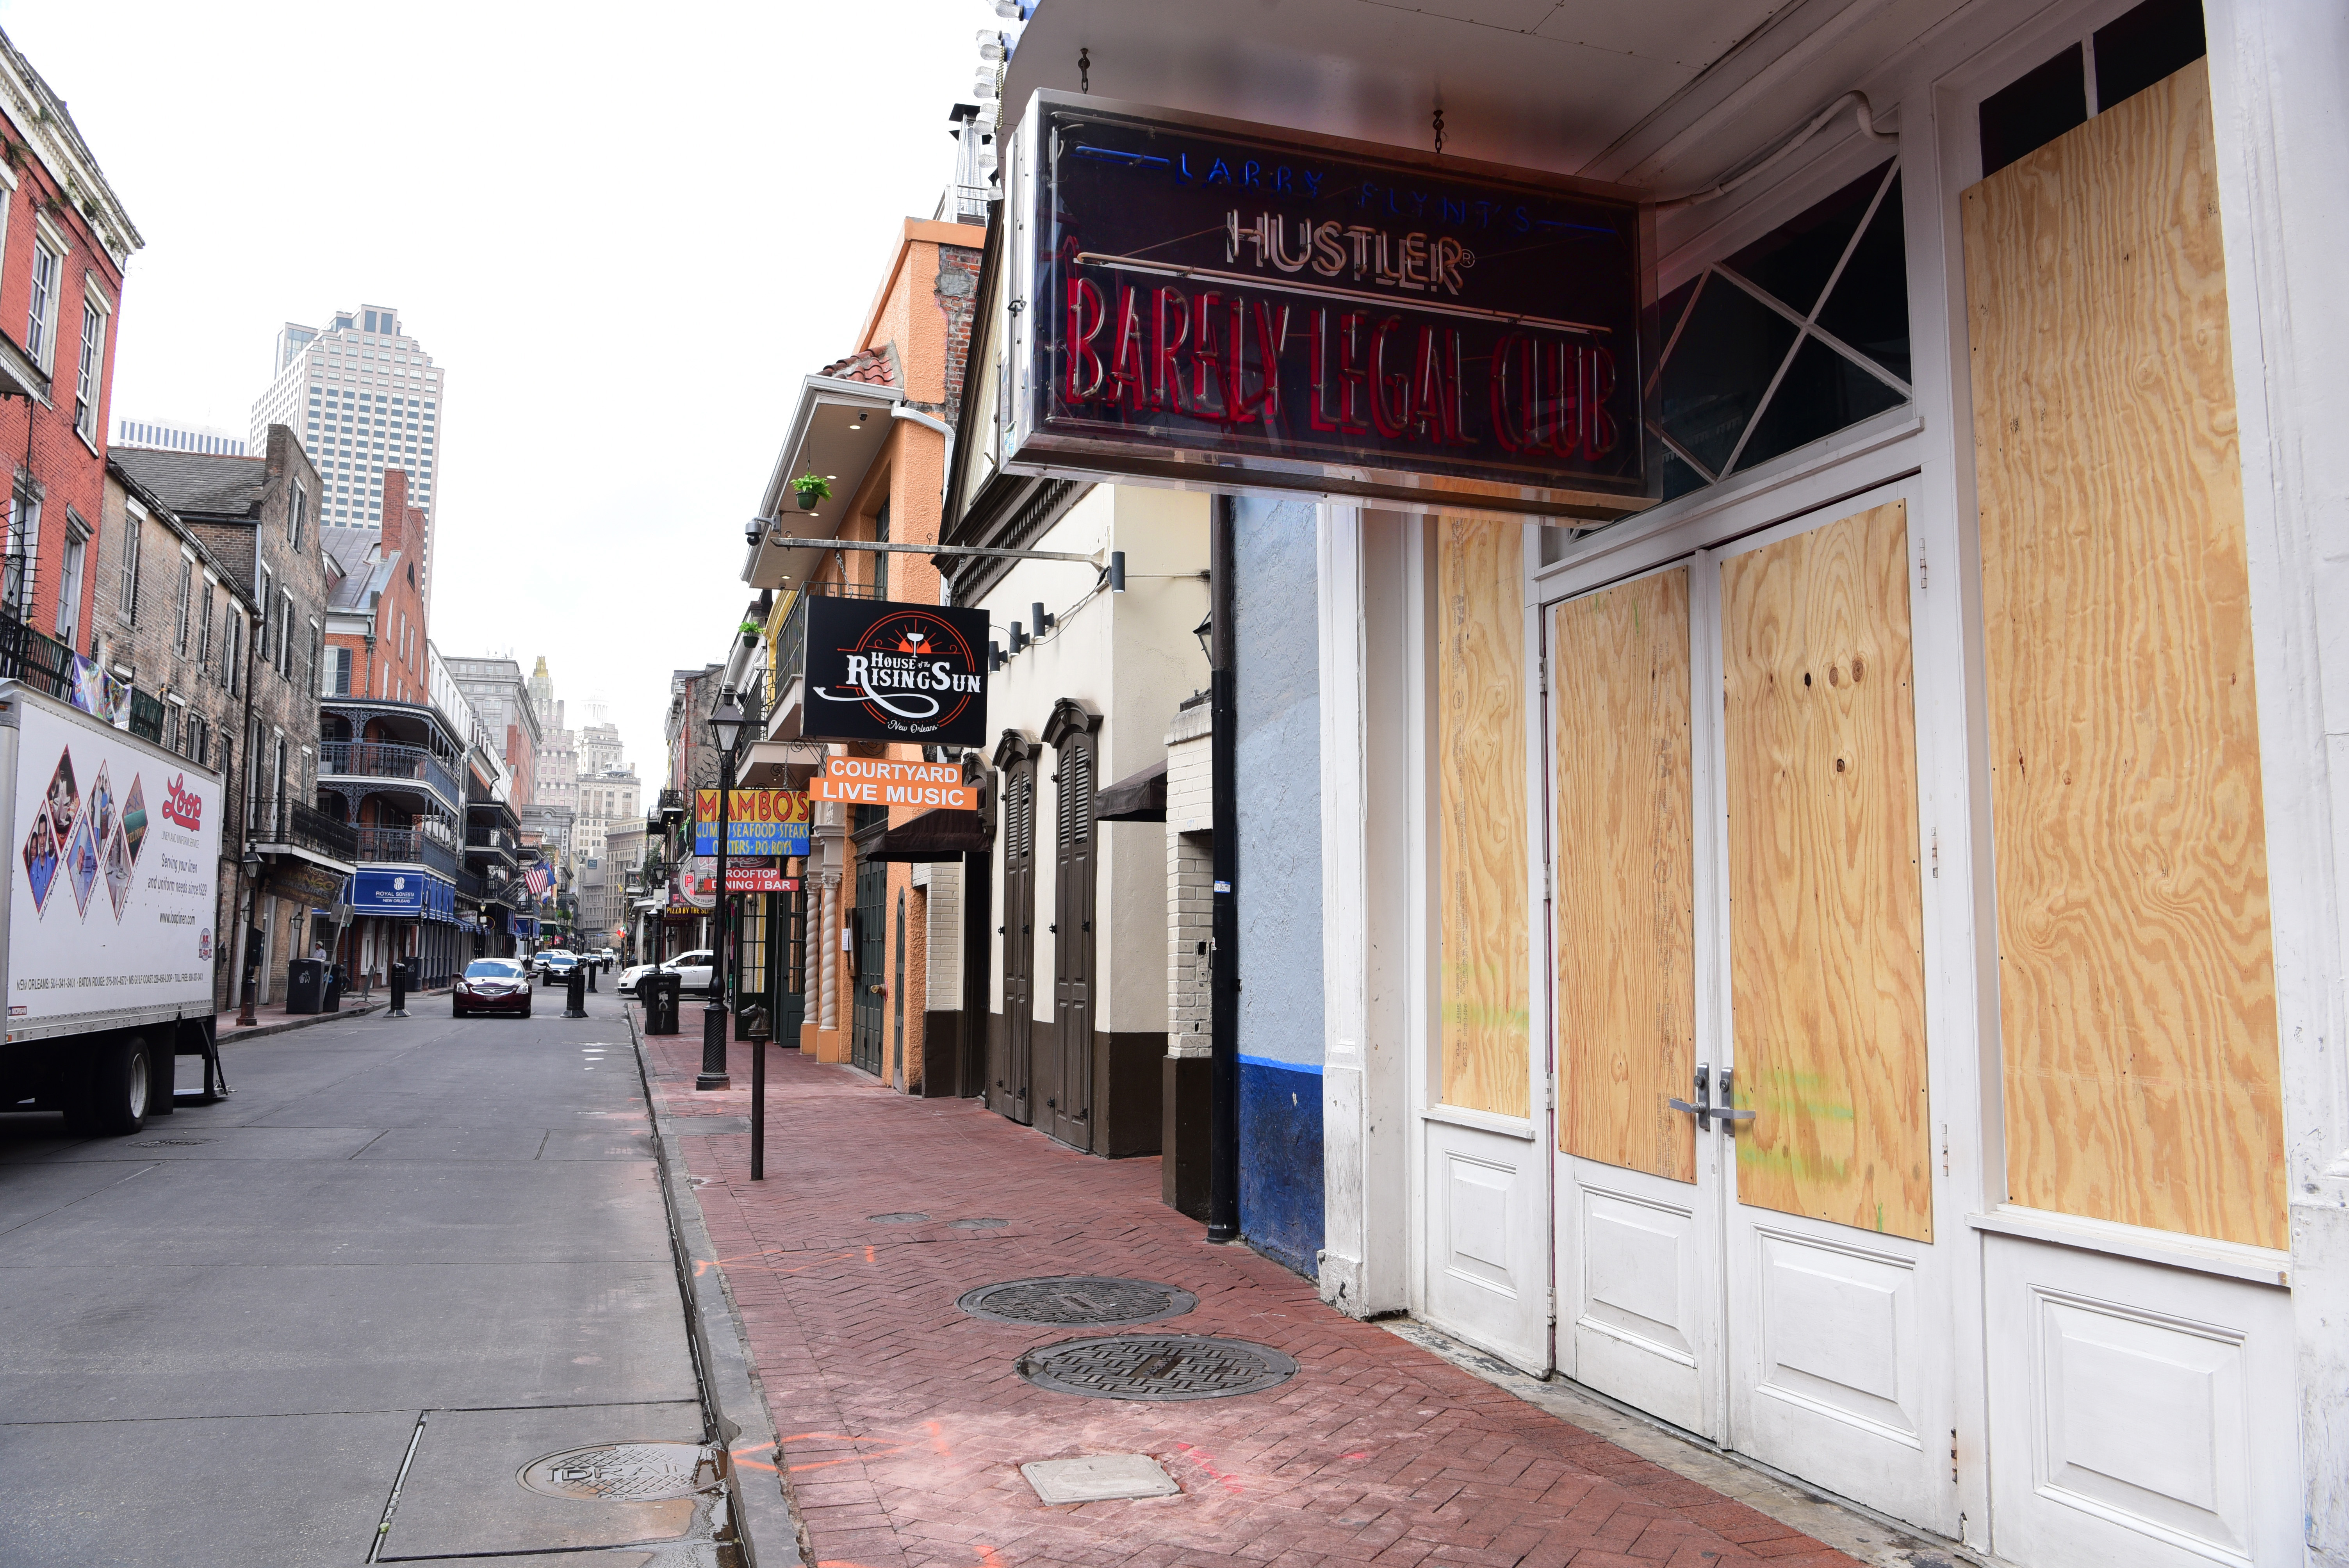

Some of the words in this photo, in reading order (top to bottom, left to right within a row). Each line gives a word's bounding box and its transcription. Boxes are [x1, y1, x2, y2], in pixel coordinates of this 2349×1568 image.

[1176, 152, 1324, 200] LARRY
[1354, 182, 1531, 233] FLYNT'S
[1064, 276, 1290, 424] BARELY
[1310, 306, 1479, 445] LEGAL
[1490, 331, 1620, 461] CLUB
[871, 652, 916, 669] HOUSE
[846, 655, 931, 690] RISING
[931, 662, 981, 693] SUN
[888, 720, 907, 731] New
[911, 724, 937, 733] Orleans
[831, 760, 958, 782] COURTYARD
[162, 773, 201, 832] Loop
[823, 782, 877, 801] LIVE
[886, 786, 964, 806] MUSIC
[161, 830, 170, 841] LINEN
[177, 835, 189, 845] UNIFORM
[189, 837, 199, 848] SERVICE
[696, 823, 730, 838] GUM
[733, 823, 776, 838] SEAFOOD
[779, 823, 809, 838] STEAKS
[713, 839, 749, 855] OSTERS
[39, 868, 59, 923] HEALTHCARE
[59, 845, 68, 870] LINEN
[70, 807, 83, 842] NAPKINS
[88, 875, 99, 904] APPAREL
[100, 842, 110, 869] TOWELS
[110, 818, 118, 837] MOPS
[162, 853, 177, 873] Serving
[178, 860, 187, 873] your
[188, 859, 197, 873] linen
[726, 869, 777, 878] ROOFTOP
[148, 875, 157, 889] and
[158, 877, 175, 892] uniform
[176, 880, 187, 894] needs
[281, 879, 329, 898] DAIQUIRIS
[711, 880, 754, 889] DNING
[765, 880, 791, 889] BAR
[312, 896, 330, 905] BEER
[159, 910, 195, 927] www.looplinen.com
[29, 978, 50, 989] ORLEANS:
[79, 977, 91, 987] BATON
[92, 976, 105, 987] ROUGE:
[129, 975, 134, 985] MS
